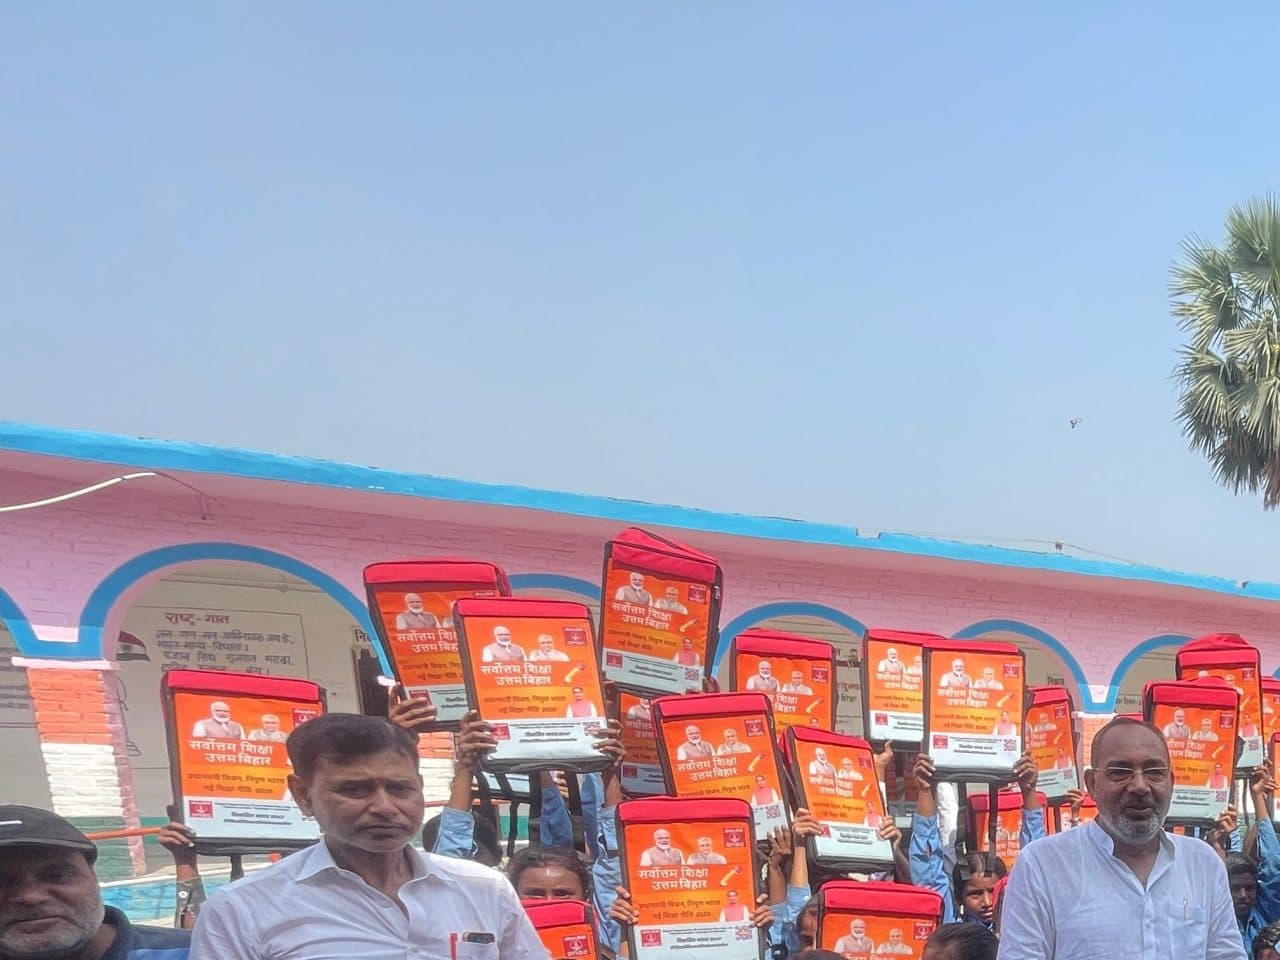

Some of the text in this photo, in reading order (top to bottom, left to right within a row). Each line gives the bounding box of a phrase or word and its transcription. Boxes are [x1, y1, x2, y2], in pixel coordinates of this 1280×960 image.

[612, 602, 672, 621] सर्वोत्तम शिक्षा
[622, 613, 669, 630] उत्तम बिहार
[480, 662, 552, 675] सर्वोत्तम शिक्षा
[495, 675, 552, 686] उत्तम बिहार
[189, 738, 273, 755] सर्वोत्तम शिक्षा
[205, 752, 272, 766] उत्तम बिहार
[677, 756, 737, 772] सर्वोत्तम शिक्षा
[690, 767, 737, 782] उत्तम बिहार
[638, 866, 709, 879] सर्वोत्तम शिक्षा
[651, 879, 707, 890] उत्तम बिहार
